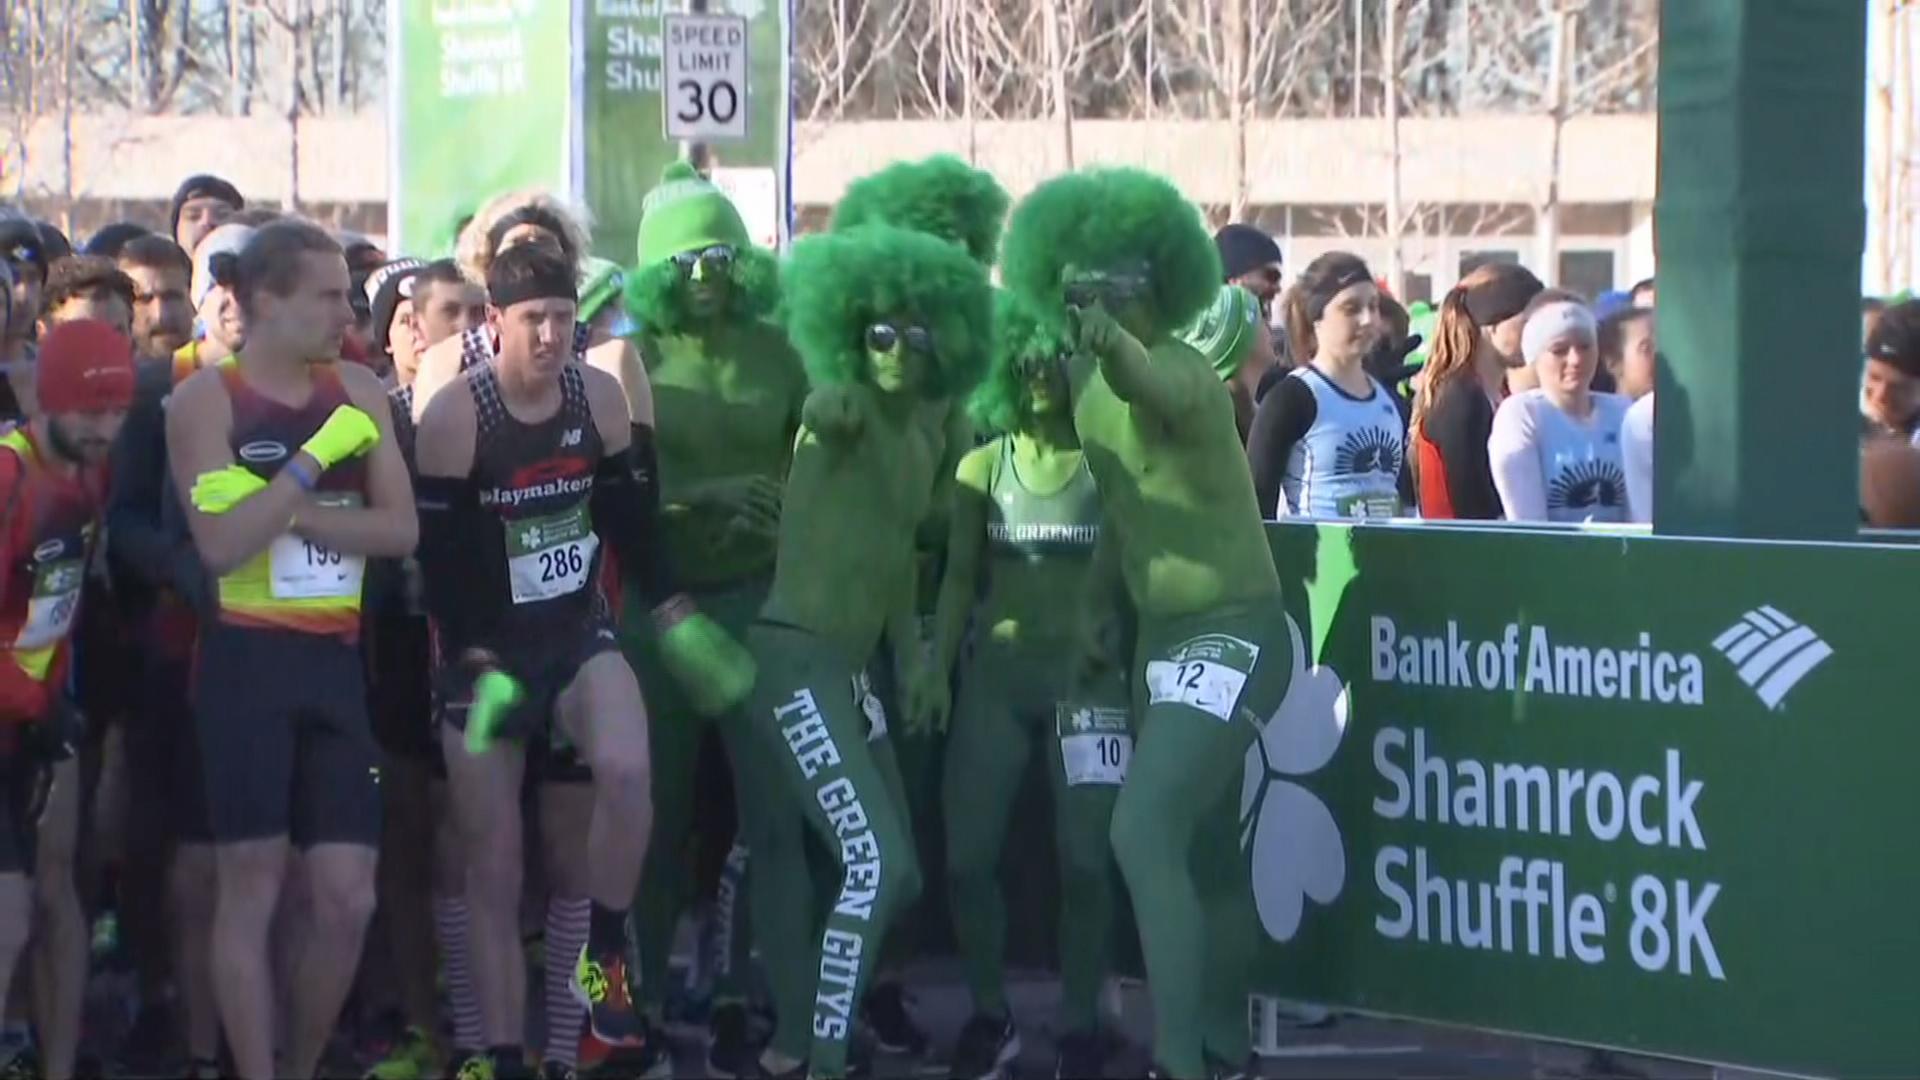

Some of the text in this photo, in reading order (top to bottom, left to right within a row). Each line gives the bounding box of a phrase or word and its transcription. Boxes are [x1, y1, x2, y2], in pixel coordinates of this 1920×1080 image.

[671, 25, 741, 46] SPEED
[678, 51, 731, 71] LIMIT
[677, 79, 738, 124] 30
[538, 543, 583, 584] 286
[1175, 662, 1205, 689] 12
[1371, 615, 1704, 705] Bank of America
[1096, 736, 1121, 767] 10
[1372, 726, 1706, 850] Shamrock
[773, 687, 881, 1040] THE GREEN GUYS
[1374, 845, 1727, 981] Shuffle 8K
